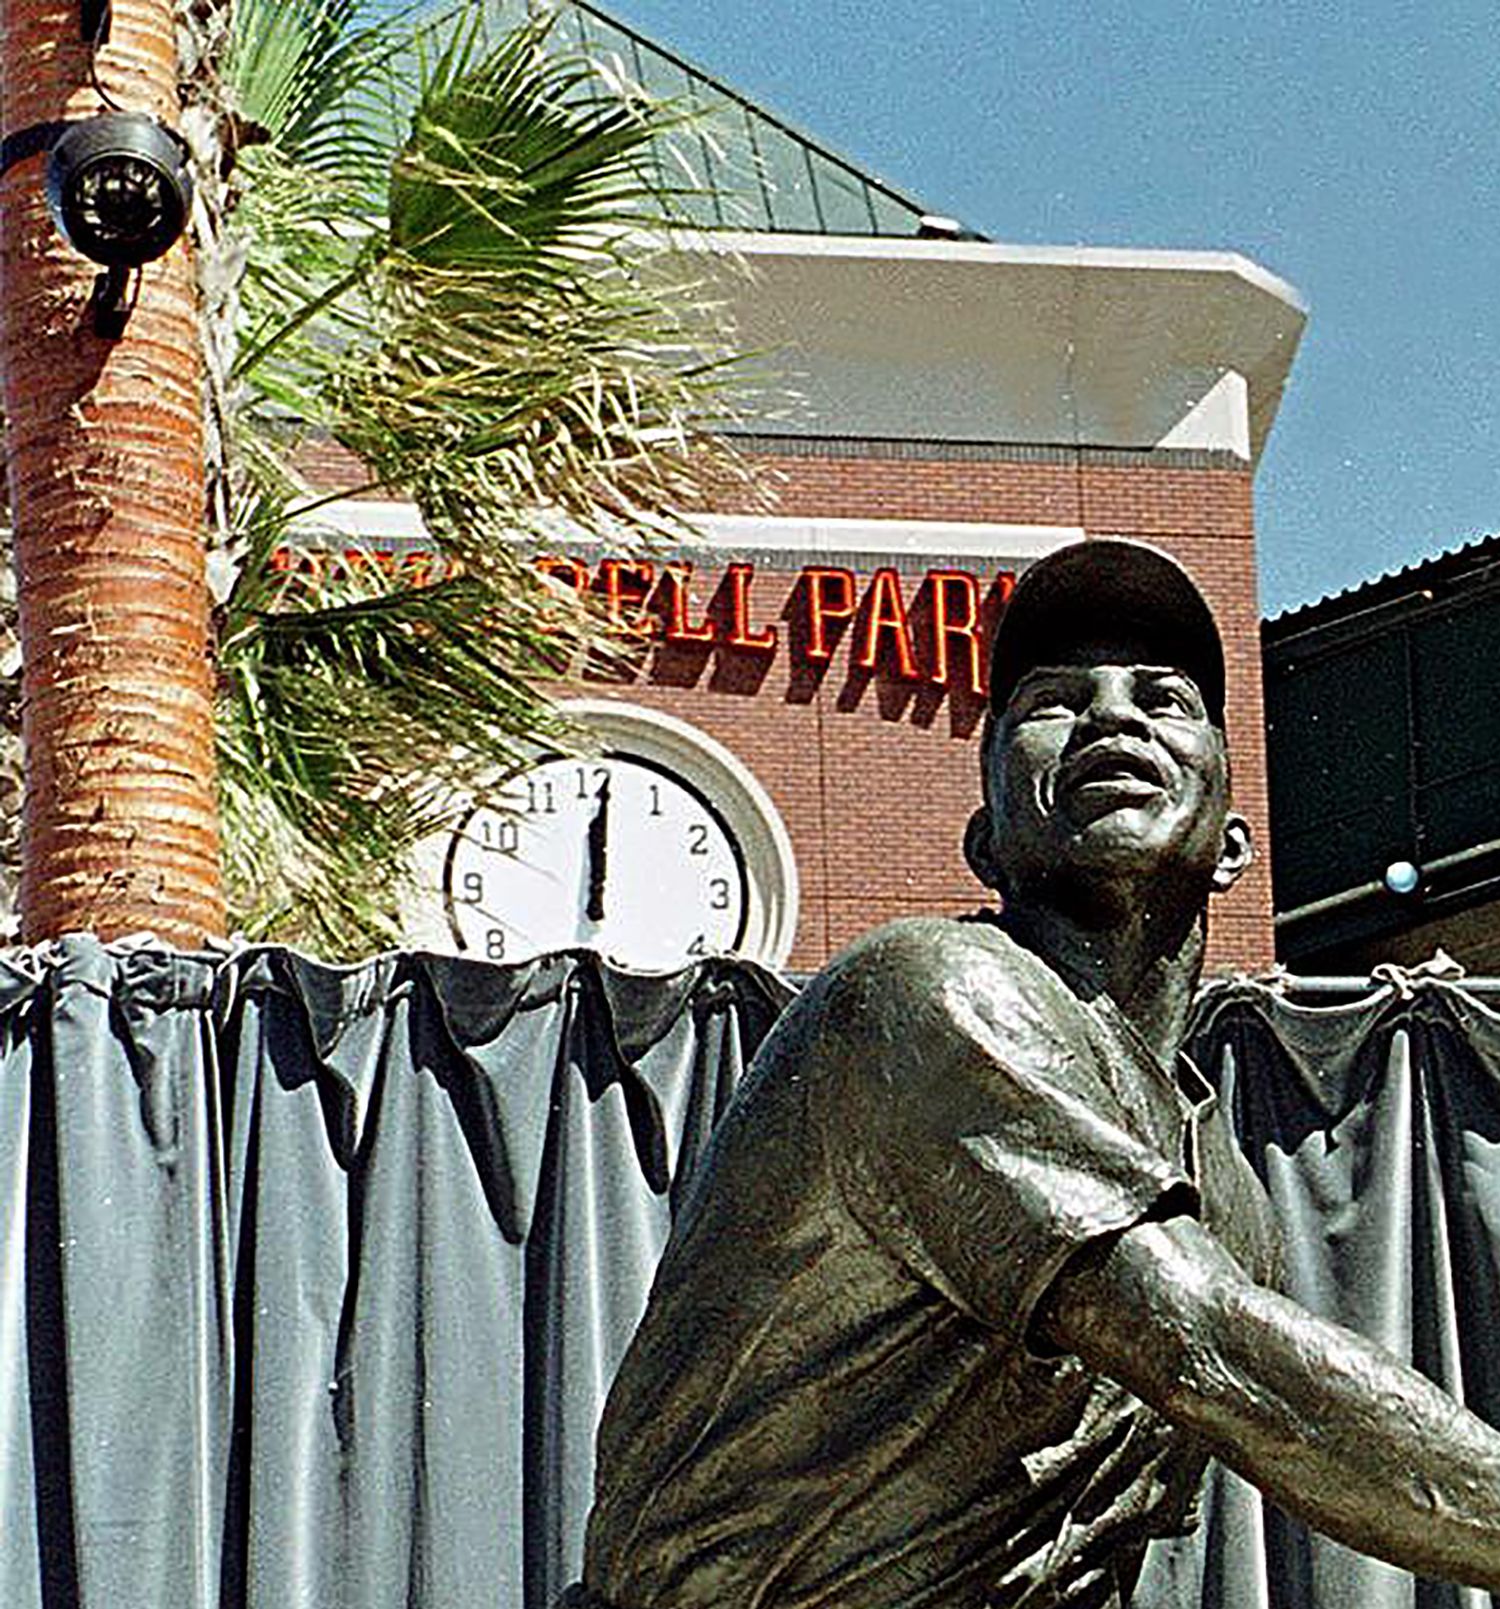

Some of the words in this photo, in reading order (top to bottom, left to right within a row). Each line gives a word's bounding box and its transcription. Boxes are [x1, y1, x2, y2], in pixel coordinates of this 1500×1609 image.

[799, 566, 1014, 696] PAR
[526, 780, 556, 813] 11
[576, 766, 612, 800] 12
[650, 784, 662, 816] 1
[482, 820, 518, 853] 10
[689, 824, 708, 855] 2
[464, 872, 483, 903] 9
[710, 878, 729, 910] 3
[486, 929, 505, 959] 8
[687, 934, 708, 956] 4
